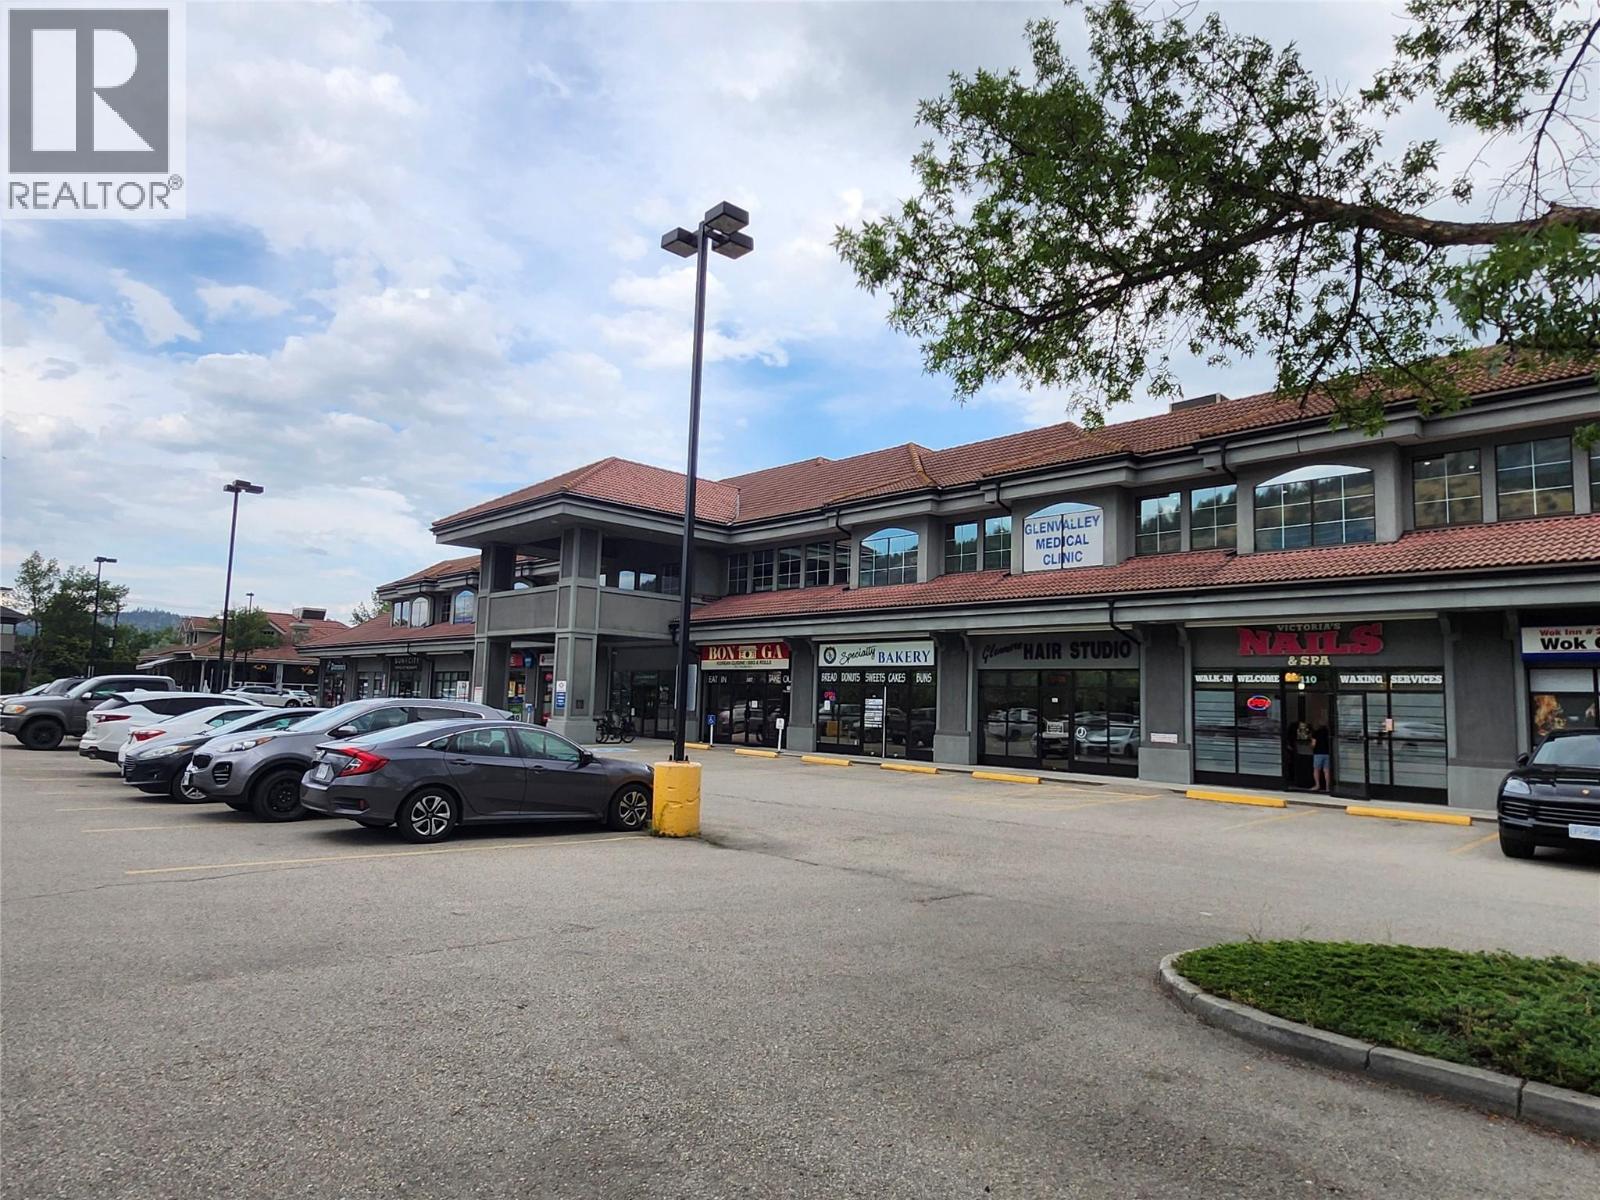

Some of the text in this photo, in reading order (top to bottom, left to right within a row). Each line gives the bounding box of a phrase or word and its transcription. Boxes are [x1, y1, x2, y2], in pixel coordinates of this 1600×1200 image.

[1024, 515, 1100, 536] GLENVALLEY
[1035, 533, 1090, 550] MEDICAL
[1042, 550, 1084, 566] CLINIC
[1276, 622, 1341, 632] VICTORIA'S
[1237, 623, 1384, 656] NAILS
[1540, 637, 1587, 650] Wok
[708, 644, 783, 660] BON GA
[839, 645, 931, 666] Specialty BAKERY
[1024, 642, 1062, 660] HAIR
[1070, 639, 1132, 660] STUDIO
[1287, 655, 1331, 667] & SPA
[708, 675, 727, 683] EAT IN
[768, 674, 781, 683] TAKE
[821, 672, 932, 683] BREAD DONUTS SWEETS CAKES BUNS
[1195, 674, 1280, 683] WALK-IN WELCOME
[1339, 674, 1443, 684] WAXING SERVICES
